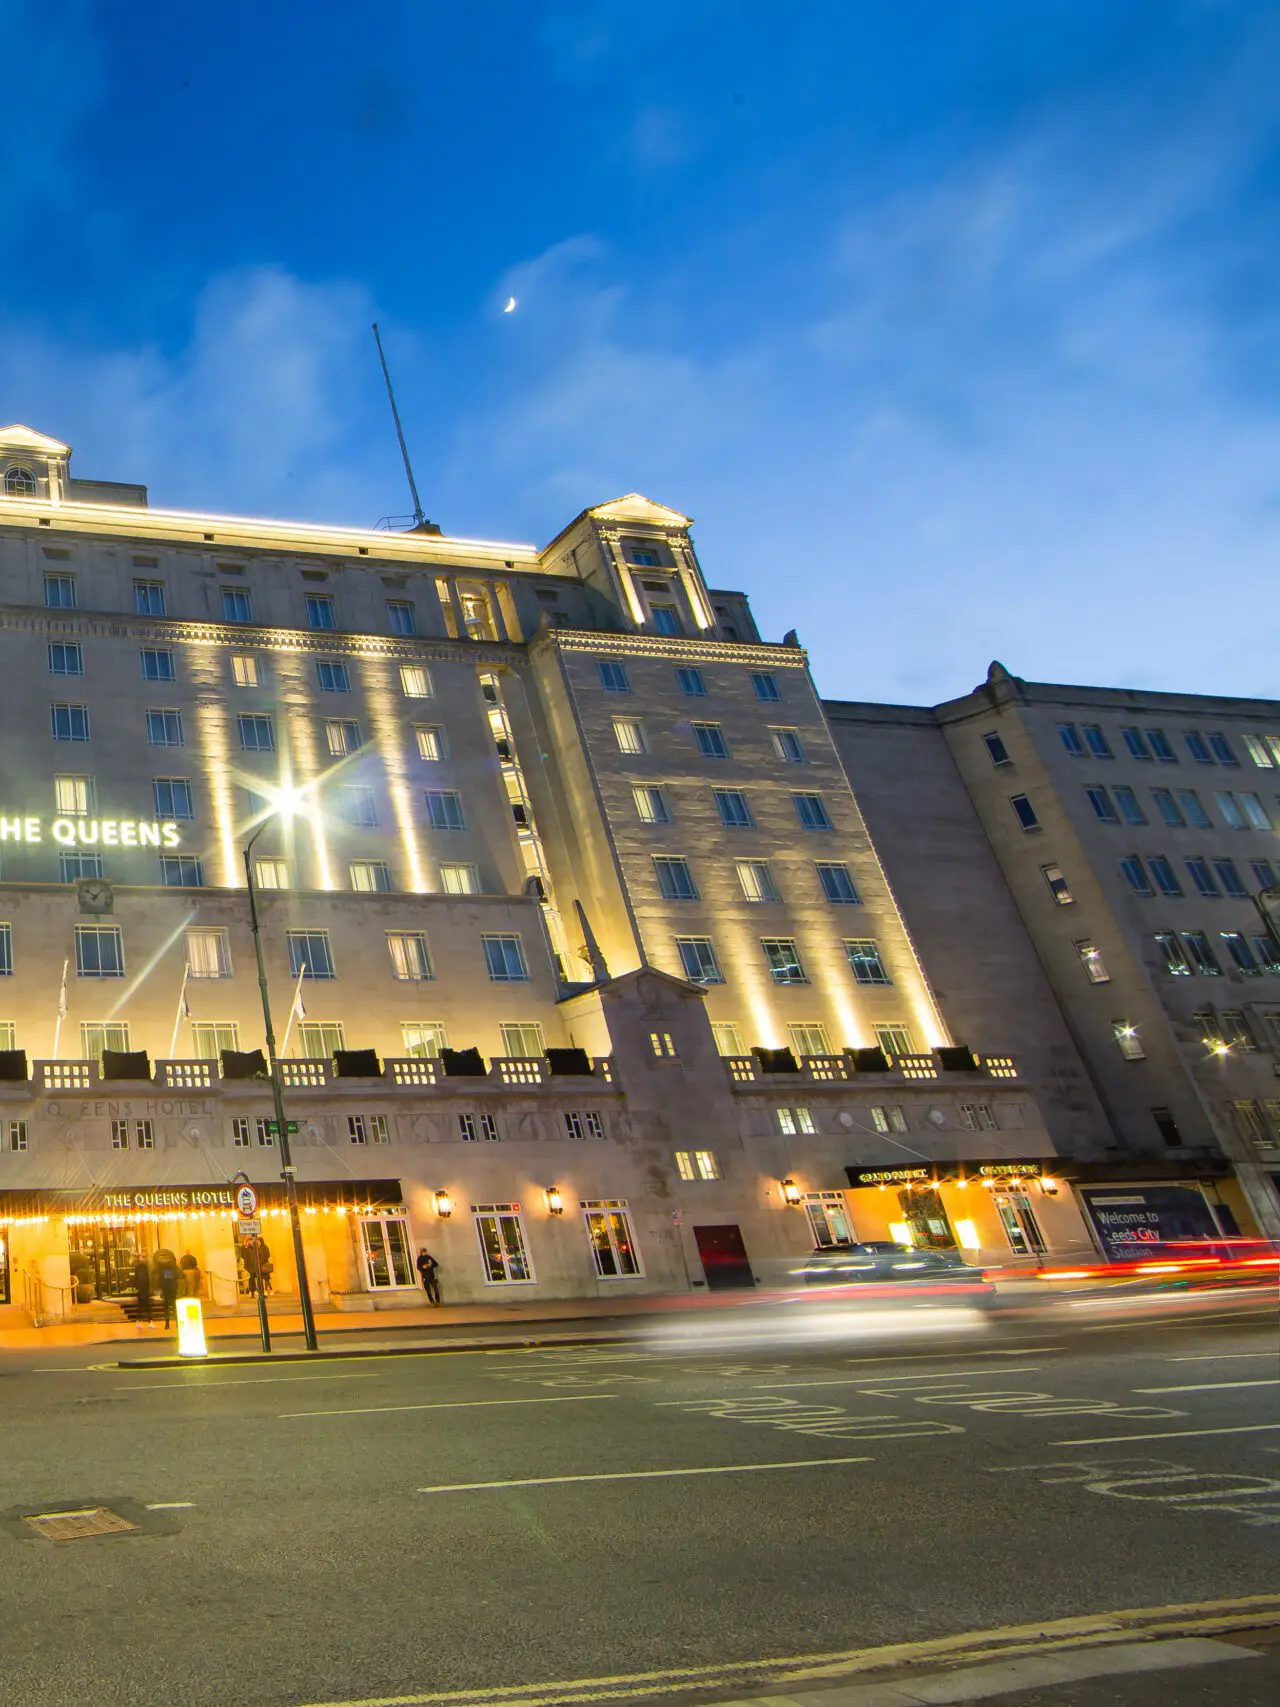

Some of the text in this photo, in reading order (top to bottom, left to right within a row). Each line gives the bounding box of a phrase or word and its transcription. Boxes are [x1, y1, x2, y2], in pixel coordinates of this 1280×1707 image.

[51, 818, 181, 848] QUEENS
[47, 1101, 212, 1118] QEENS HOTEL
[105, 1191, 235, 1208] THE QUEENS HOTEL
[1097, 1211, 1159, 1225] Welcome to
[1138, 1228, 1160, 1240] City
[1111, 1246, 1153, 1259] Station
[857, 1384, 1191, 1419] LOOP
[653, 1396, 966, 1439] ROAD
